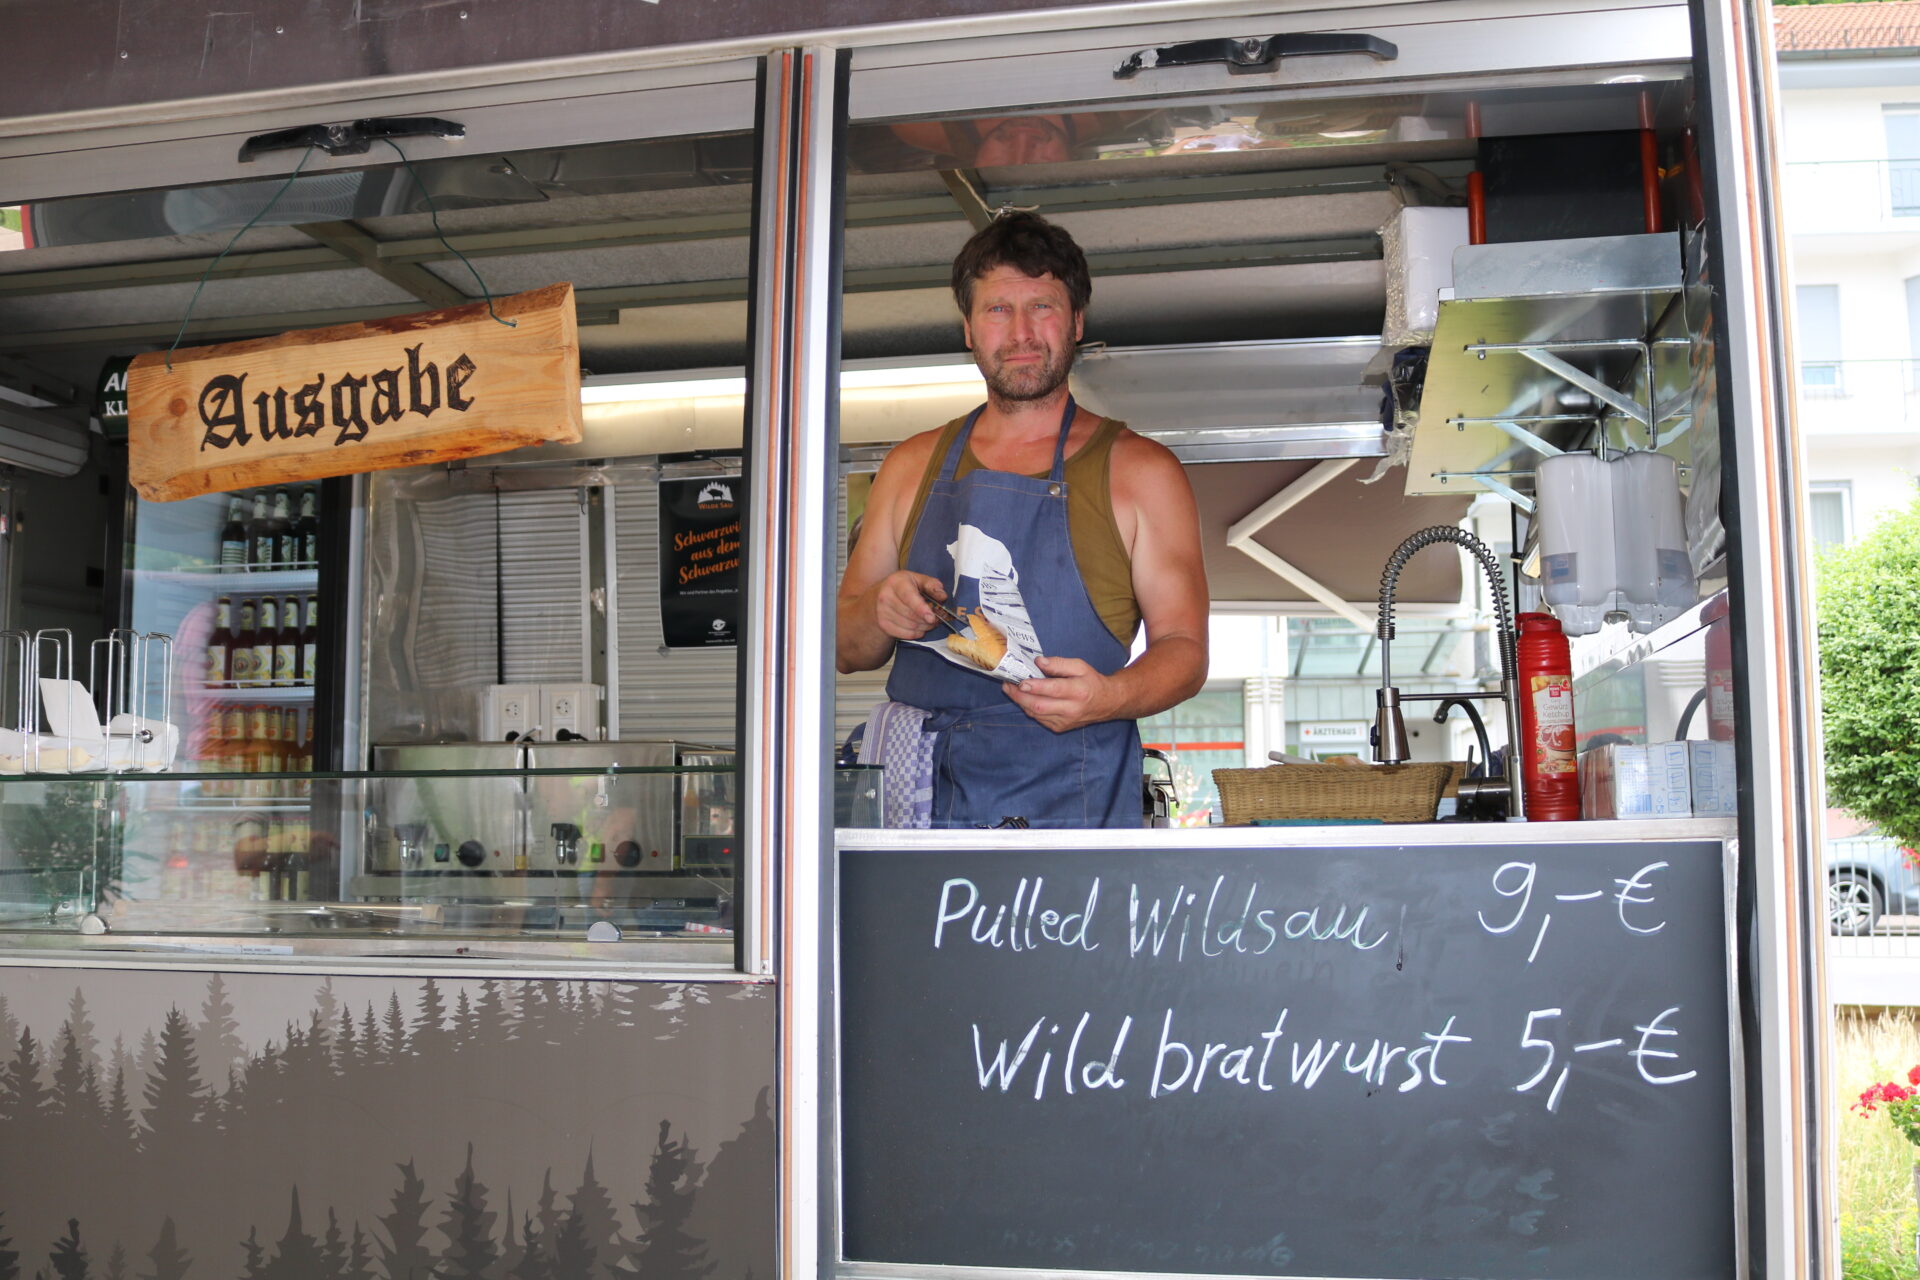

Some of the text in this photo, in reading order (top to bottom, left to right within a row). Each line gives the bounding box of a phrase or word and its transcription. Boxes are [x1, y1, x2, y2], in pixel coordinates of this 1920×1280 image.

[198, 342, 477, 451] Ausgabe
[673, 521, 741, 552] Schwarzwi
[690, 538, 741, 561] aus dem
[1007, 625, 1036, 643] News
[1313, 727, 1357, 736] ÄRZTEHAUS
[935, 877, 1100, 951] Pulled
[1130, 875, 1388, 962] Wildsau
